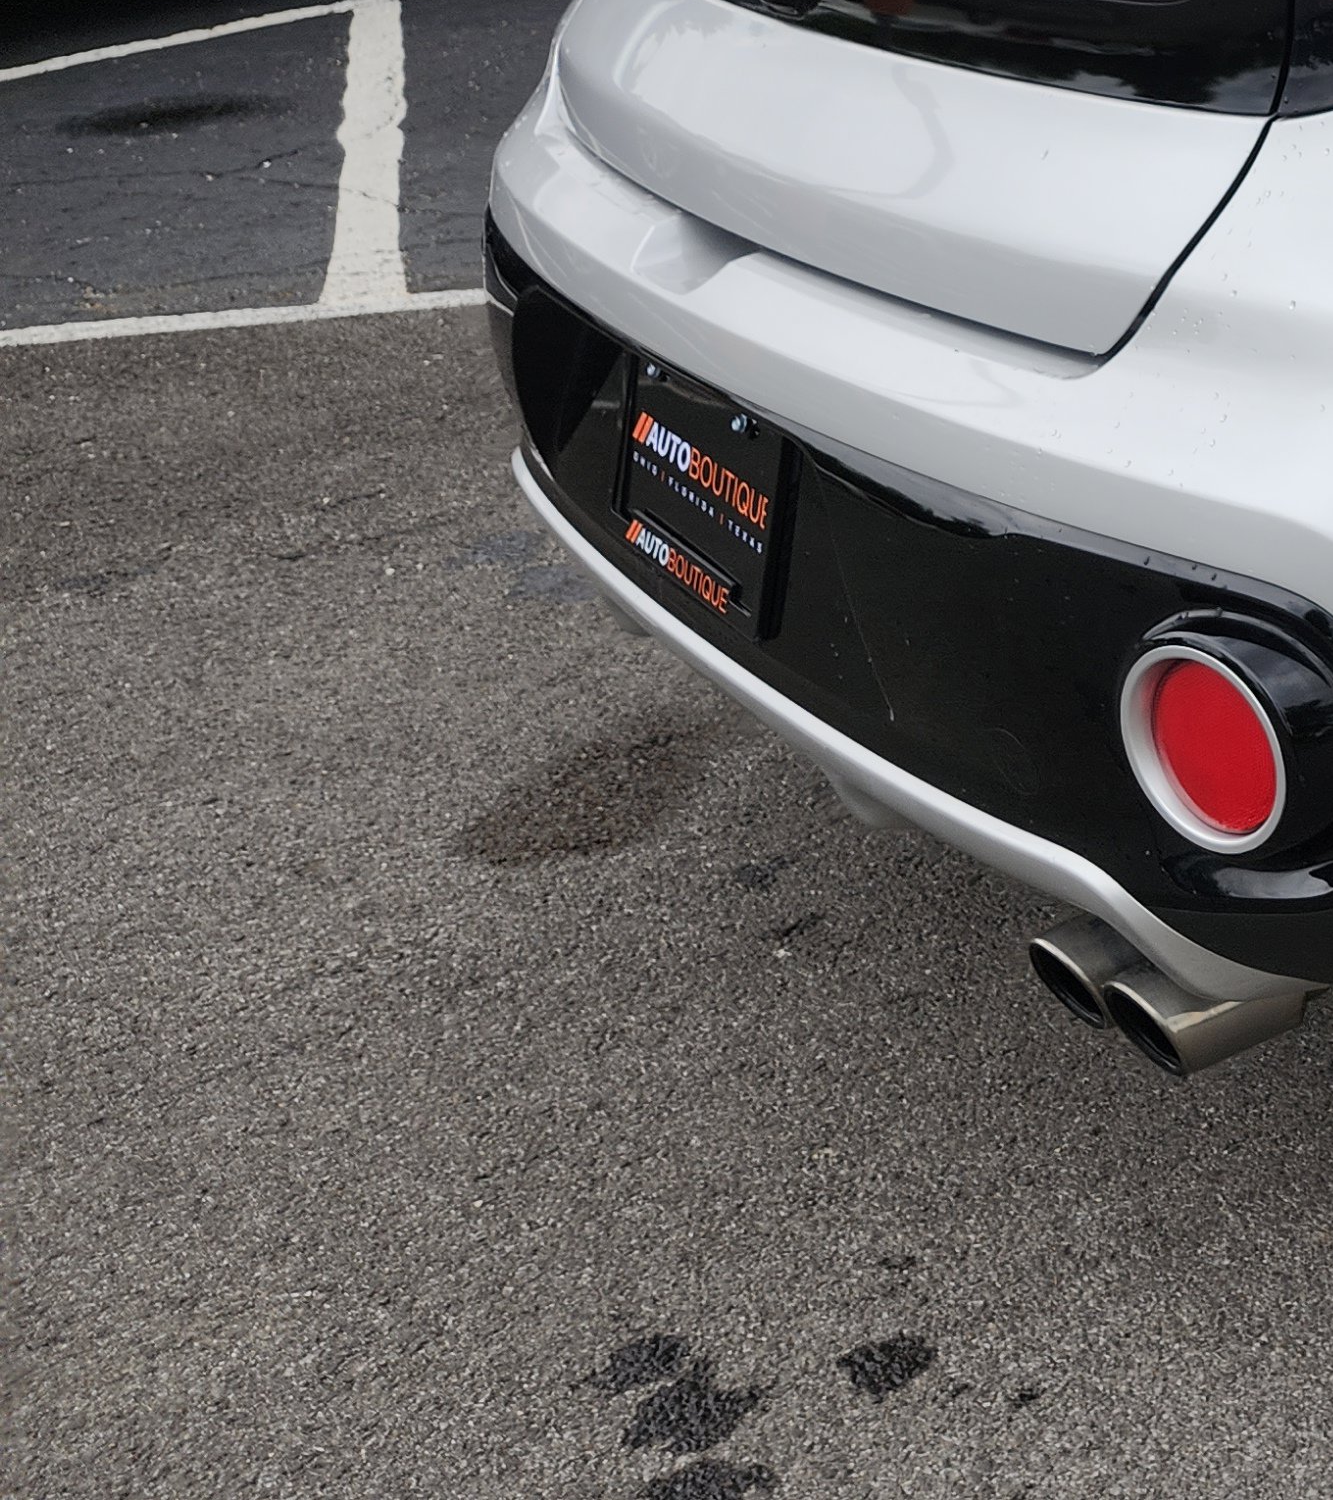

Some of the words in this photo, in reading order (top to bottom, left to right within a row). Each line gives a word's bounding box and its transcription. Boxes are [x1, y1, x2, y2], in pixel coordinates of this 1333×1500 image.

[645, 421, 769, 530] AUTOBOUTIQUE
[635, 527, 729, 615] AUTOBOUTIQUE
[728, 518, 763, 554] TEXAS
